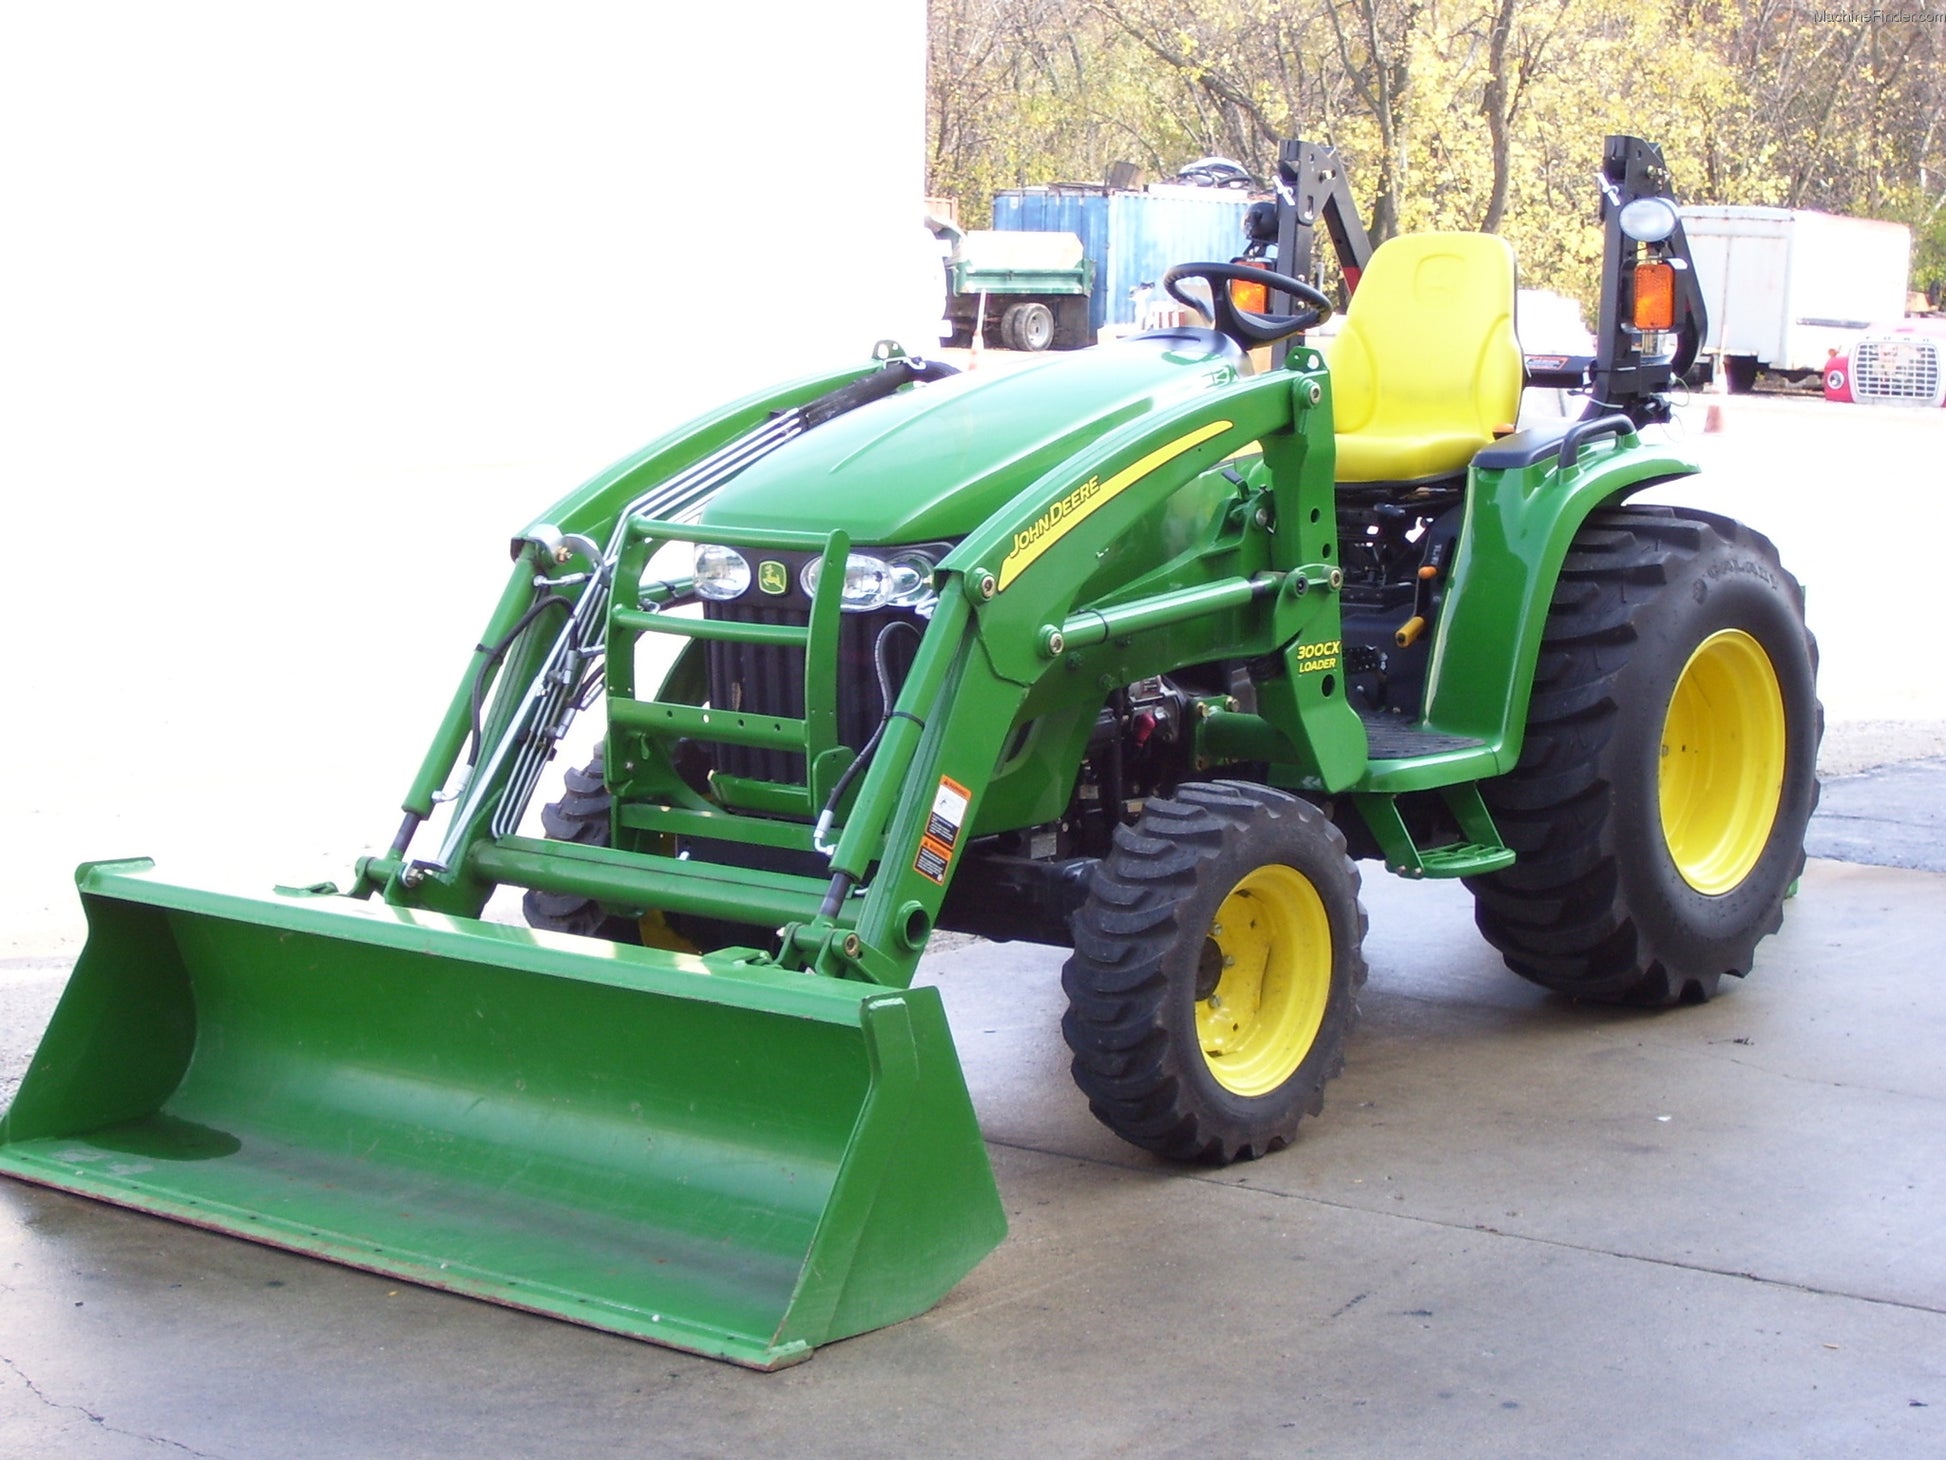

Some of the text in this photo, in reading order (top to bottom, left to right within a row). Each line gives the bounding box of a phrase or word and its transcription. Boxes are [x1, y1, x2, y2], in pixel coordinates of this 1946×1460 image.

[1009, 474, 1100, 558] JOHN DEERE
[1296, 640, 1341, 660] 300CX
[1298, 657, 1336, 673] LOADER
